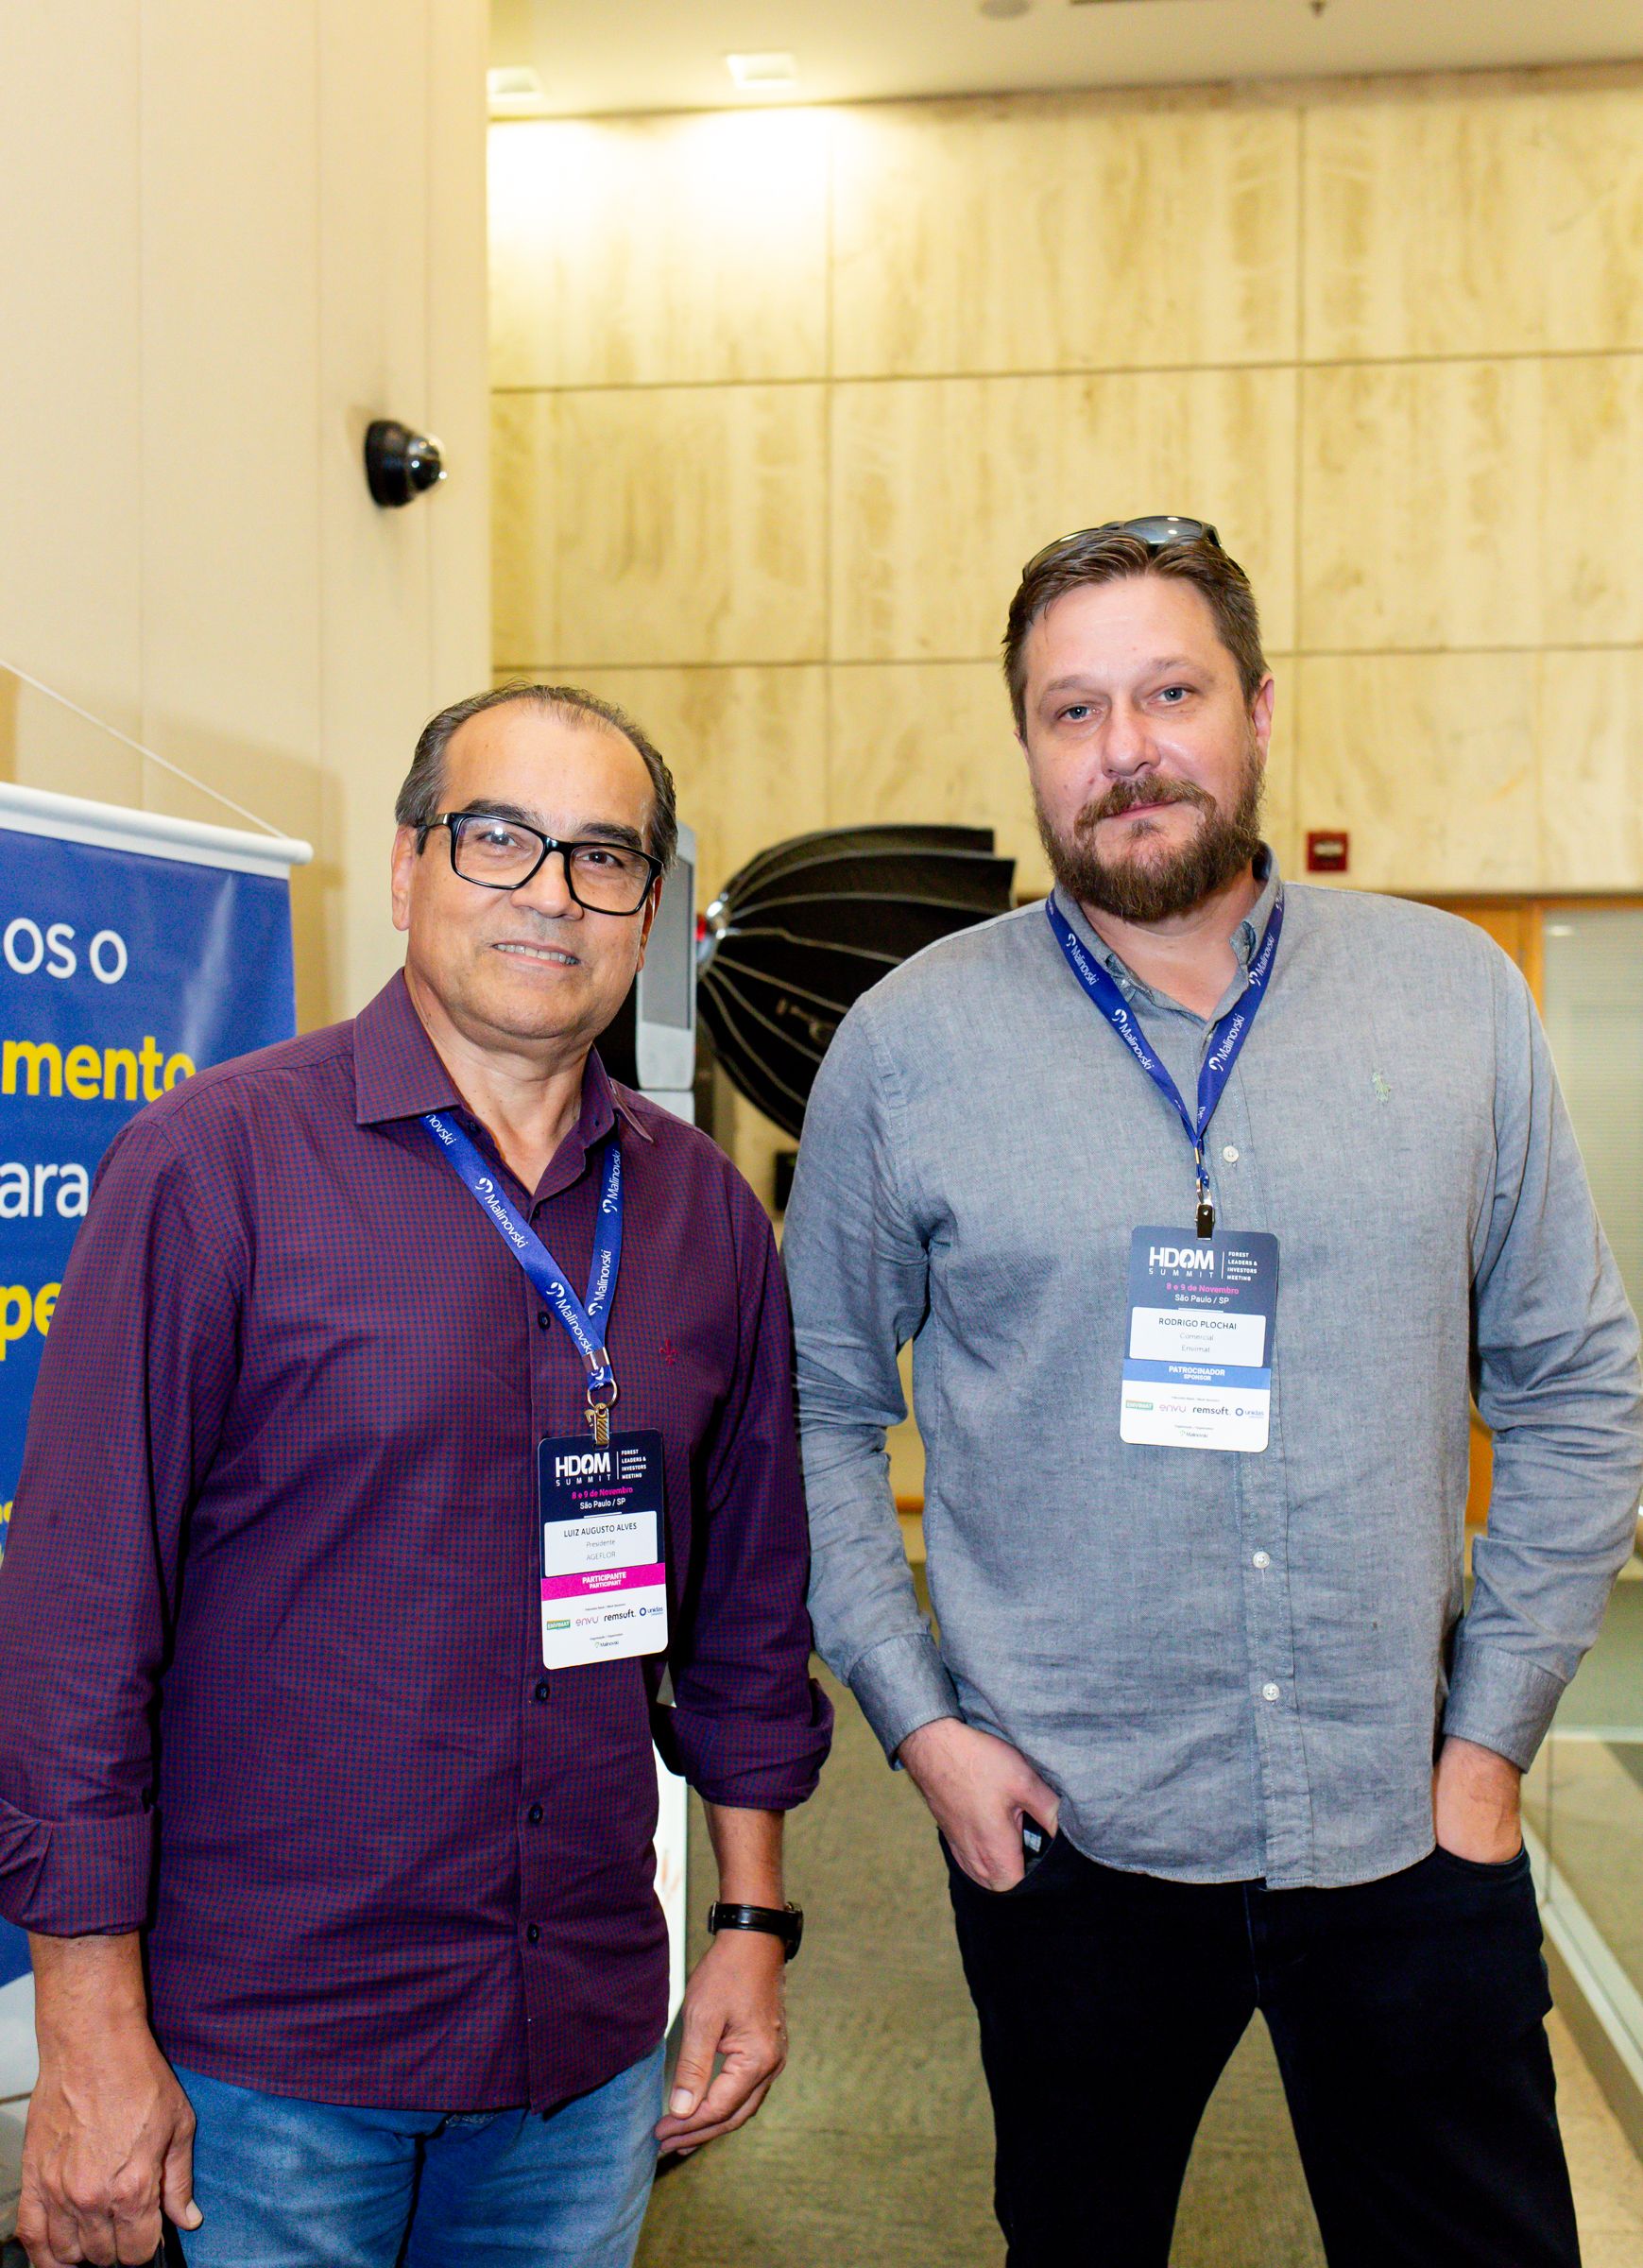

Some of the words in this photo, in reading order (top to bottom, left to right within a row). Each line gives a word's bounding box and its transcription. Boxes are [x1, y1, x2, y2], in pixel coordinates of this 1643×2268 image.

[89, 929, 128, 985] o
[1070, 945, 1100, 987] Malinovski
[1219, 1013, 1245, 1061] Malinovski
[1119, 1023, 1155, 1071] Malinovski
[607, 1148, 621, 1200] Malinovski
[485, 1194, 529, 1248] Malinovski
[1149, 1246, 1214, 1270] HDOM
[594, 1249, 612, 1301] Malinovski
[1149, 1269, 1214, 1279] SUMMIT
[1199, 1285, 1240, 1295] Novembro
[1190, 1295, 1211, 1303] Paulo
[1158, 1317, 1199, 1328] RODRIGO
[1200, 1321, 1237, 1330] PLOCHAI
[1168, 1366, 1225, 1376] PATROCINADOR
[556, 1452, 611, 1477] HDOM
[556, 1474, 611, 1486] SUMMIT
[572, 1491, 577, 1500] 8
[599, 1486, 634, 1496] Novembro
[579, 1501, 592, 1509] São
[593, 1499, 611, 1508] Paulo
[617, 1497, 626, 1505] SP
[563, 1529, 579, 1538] LUIZ
[581, 1524, 615, 1535] AUGUSTO
[617, 1522, 637, 1531] ALVES
[582, 1572, 626, 1584] PARTICIPANTE
[589, 1579, 622, 1589] PARTICIPANT
